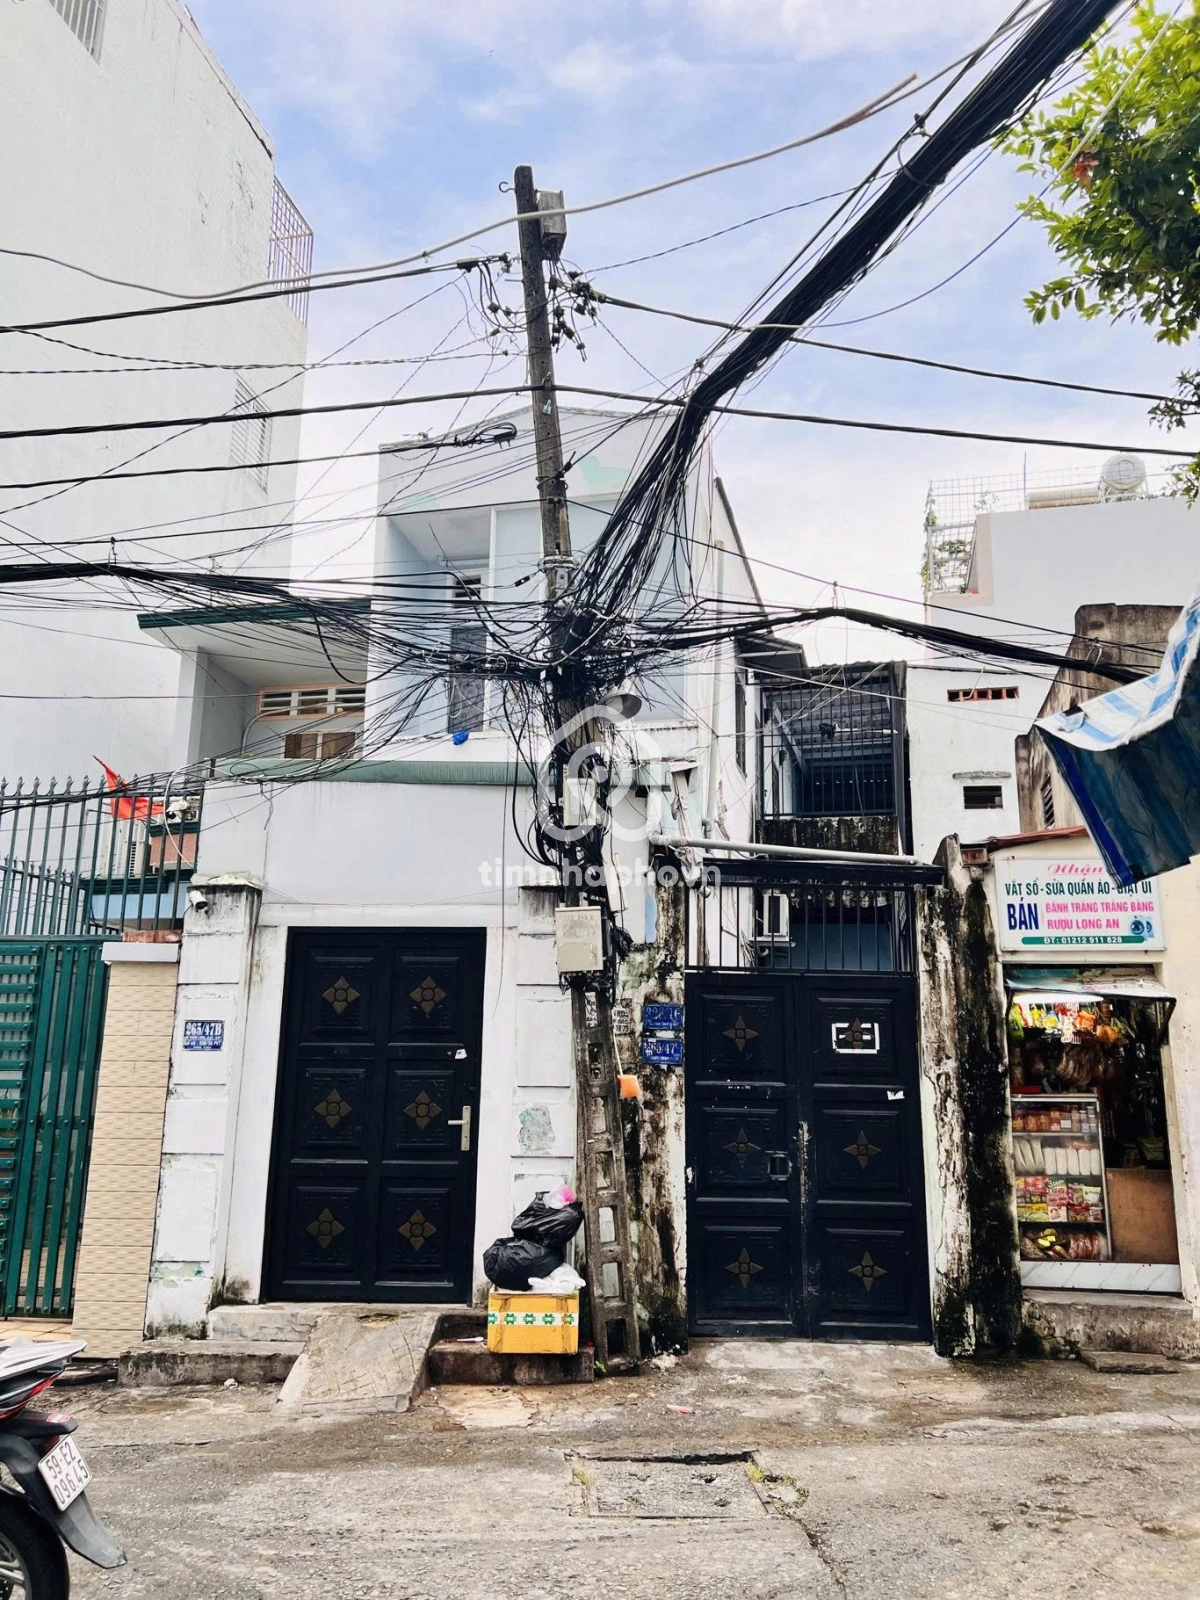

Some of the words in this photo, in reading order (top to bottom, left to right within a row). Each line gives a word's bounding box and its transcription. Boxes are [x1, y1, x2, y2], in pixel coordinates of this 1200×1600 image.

[1048, 863, 1104, 876] Nhận
[1046, 878, 1065, 895] SỬA
[1097, 879, 1110, 895] ÁO
[1007, 897, 1040, 931] BÁN
[1047, 918, 1073, 932] RƯỢU
[1076, 918, 1102, 930] LONG
[1105, 918, 1120, 929] AN
[186, 1022, 222, 1036] 265/47B
[54, 1458, 89, 1505] 096.45
